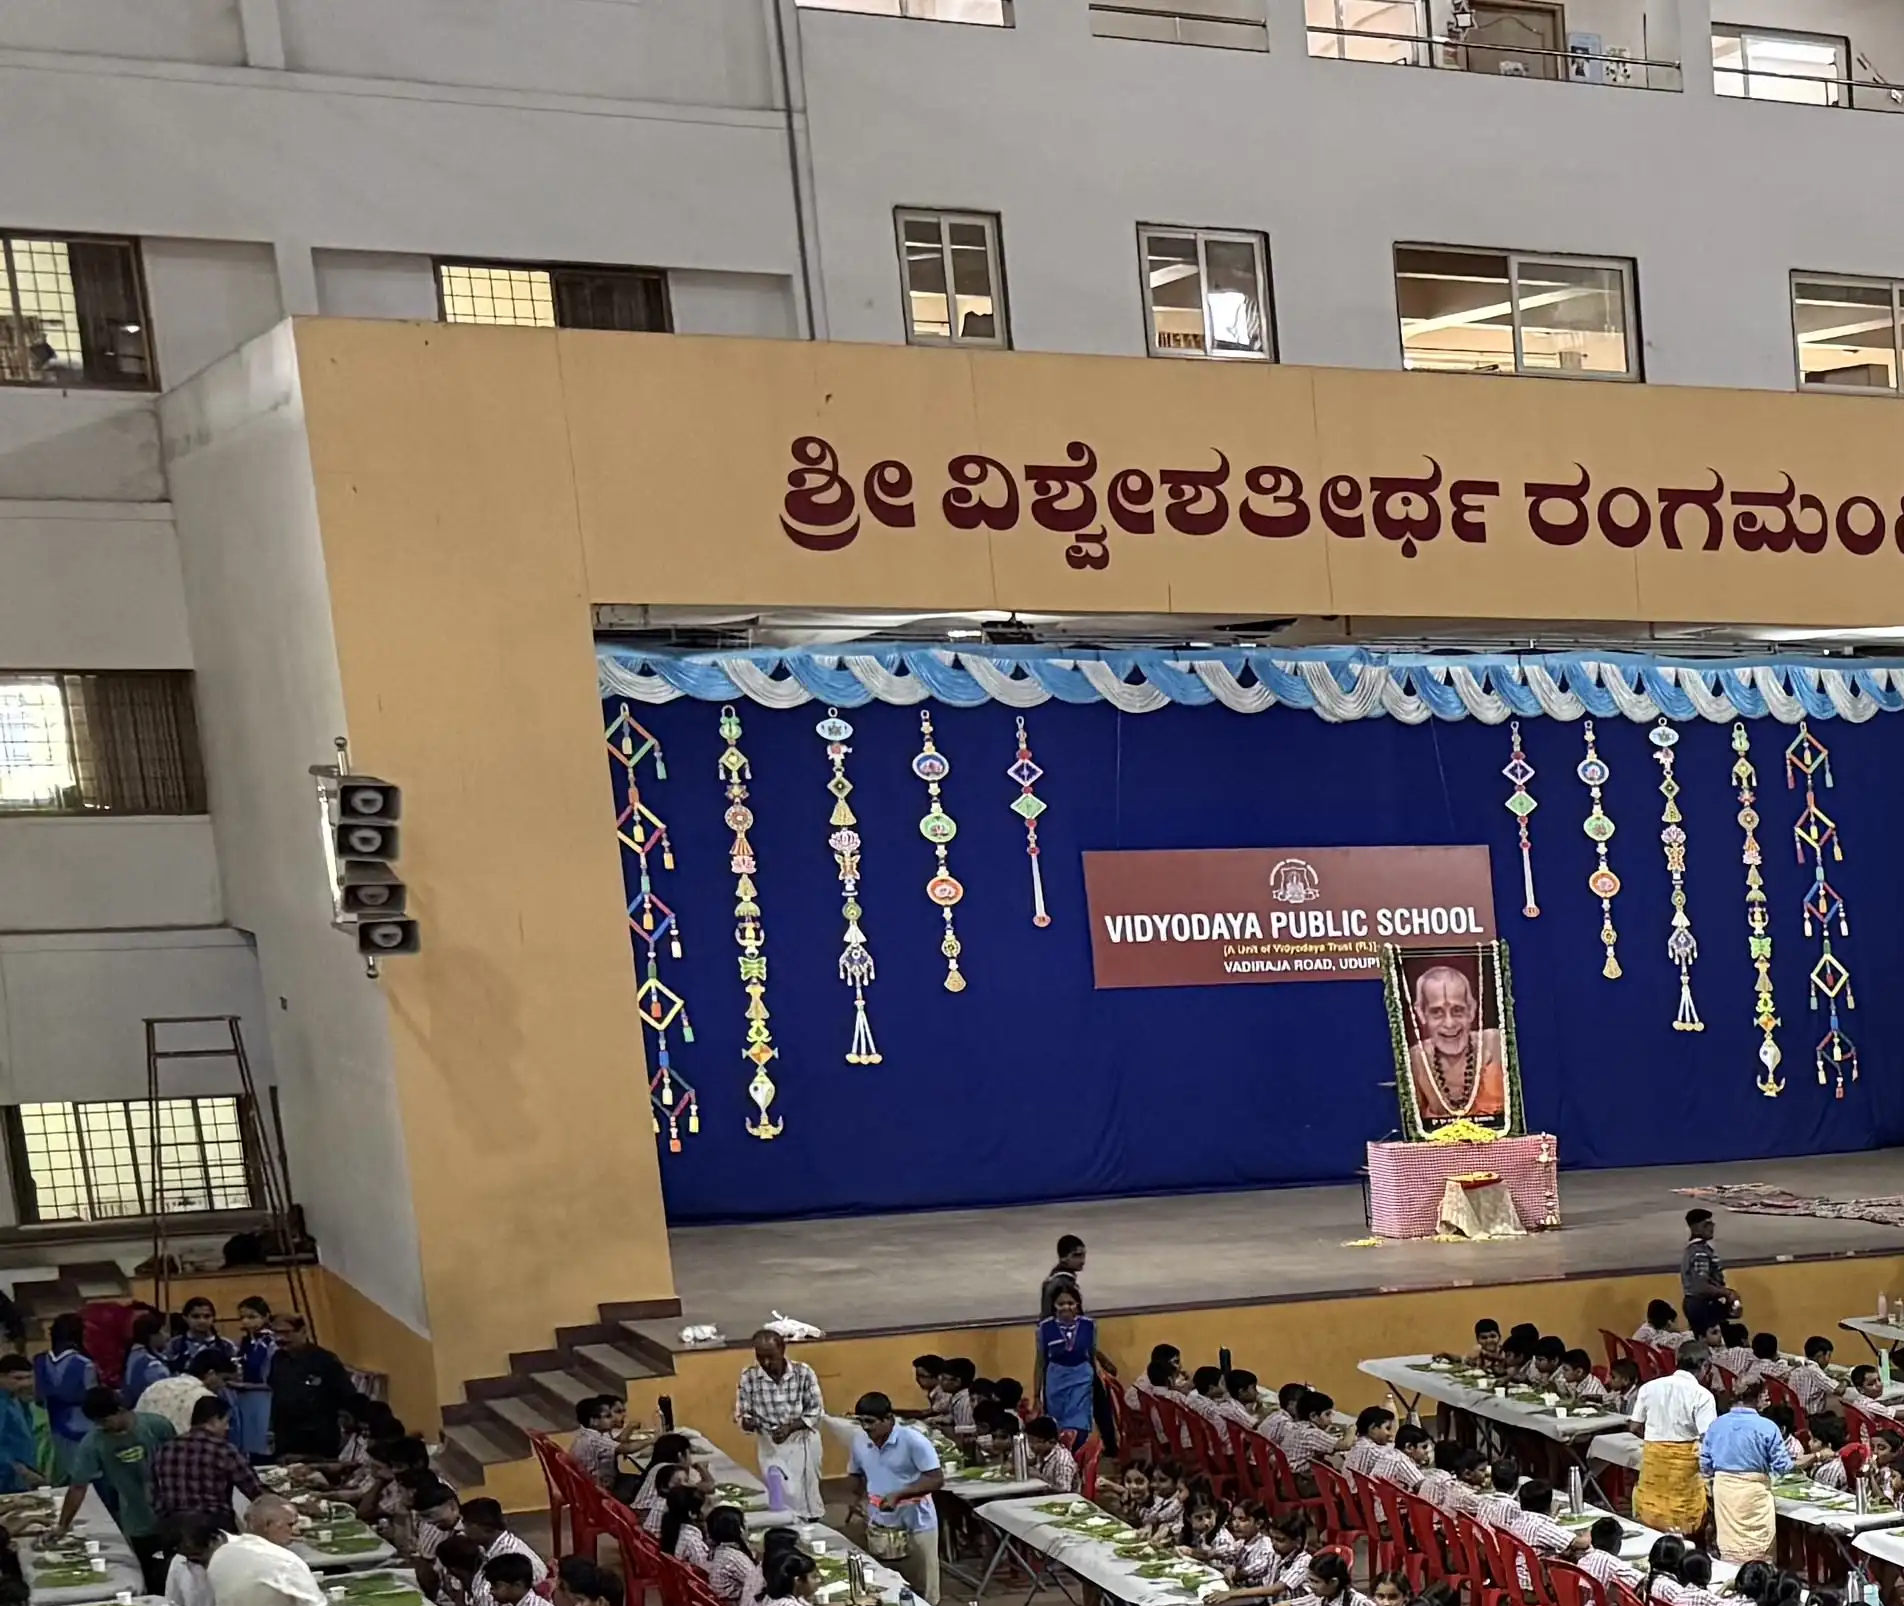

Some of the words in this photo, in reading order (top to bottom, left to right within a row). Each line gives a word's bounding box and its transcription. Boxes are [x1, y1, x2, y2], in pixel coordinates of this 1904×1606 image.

[779, 435, 916, 552] ಶ್ರೀ
[941, 440, 1500, 571] ವಿಶ್ವೇಶತೀರ್ಥ
[1104, 912, 1264, 943] VIDYODAYA
[1271, 909, 1369, 939] PUBLIC
[1376, 906, 1484, 936] SCHOOL
[1223, 960, 1291, 973] VADIRAJA
[1293, 958, 1336, 971] ROAD,
[1338, 957, 1380, 969] UDUPI
